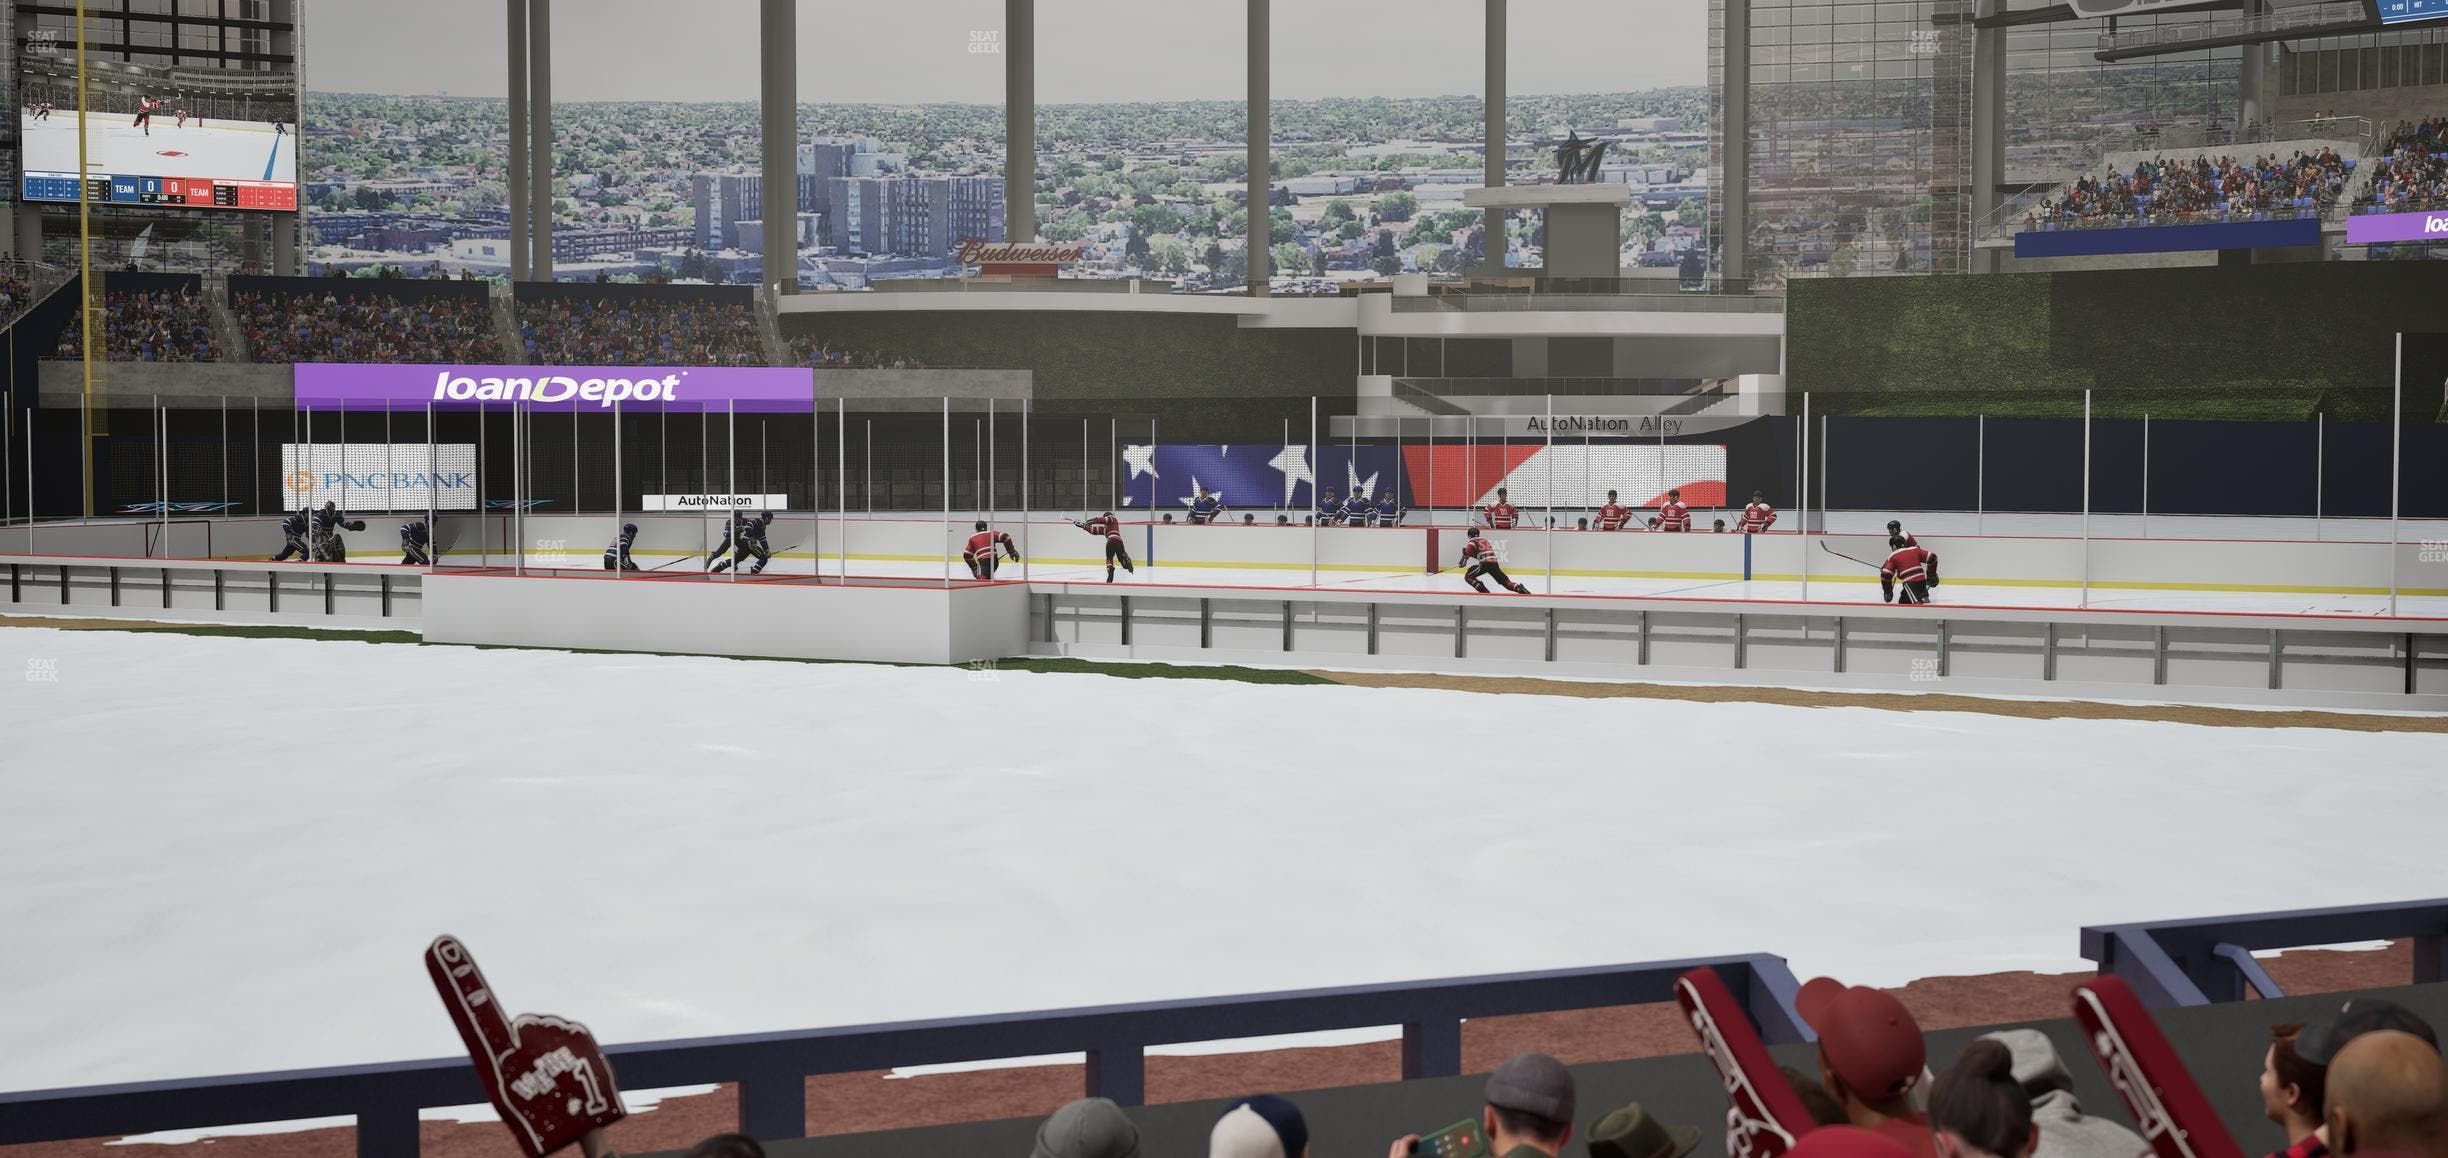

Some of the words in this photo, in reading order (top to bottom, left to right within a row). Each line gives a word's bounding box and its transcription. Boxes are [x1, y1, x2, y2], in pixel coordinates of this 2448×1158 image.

[115, 184, 134, 194] TEAM
[147, 180, 154, 191] 0
[171, 181, 178, 192] 0
[190, 188, 208, 197] TEAM
[953, 238, 1084, 264] Budweiser
[433, 371, 681, 408] loanDepot
[1527, 415, 1629, 432] AutoNation
[1640, 415, 1683, 435] Alley
[678, 495, 752, 506] AutoNation
